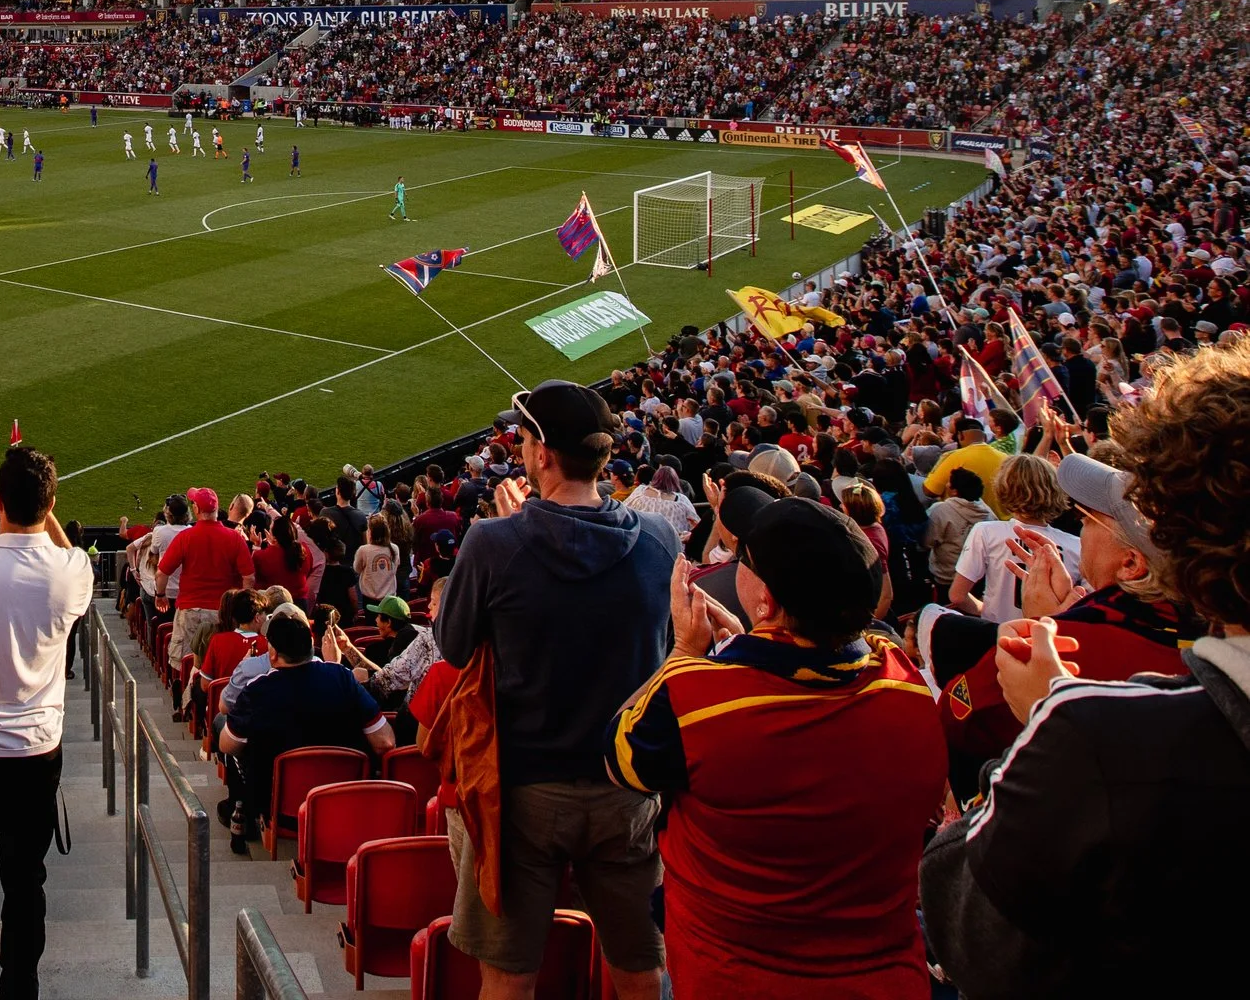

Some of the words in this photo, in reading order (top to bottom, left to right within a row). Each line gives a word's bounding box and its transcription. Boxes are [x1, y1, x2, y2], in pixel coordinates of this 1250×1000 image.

[642, 7, 673, 19] SALT
[675, 7, 709, 18] LAKE
[302, 11, 352, 28] BANK
[503, 119, 543, 129] BODYARMOR
[552, 122, 582, 132] Reagan
[722, 131, 781, 144] Continental
[792, 137, 817, 146] TIRE
